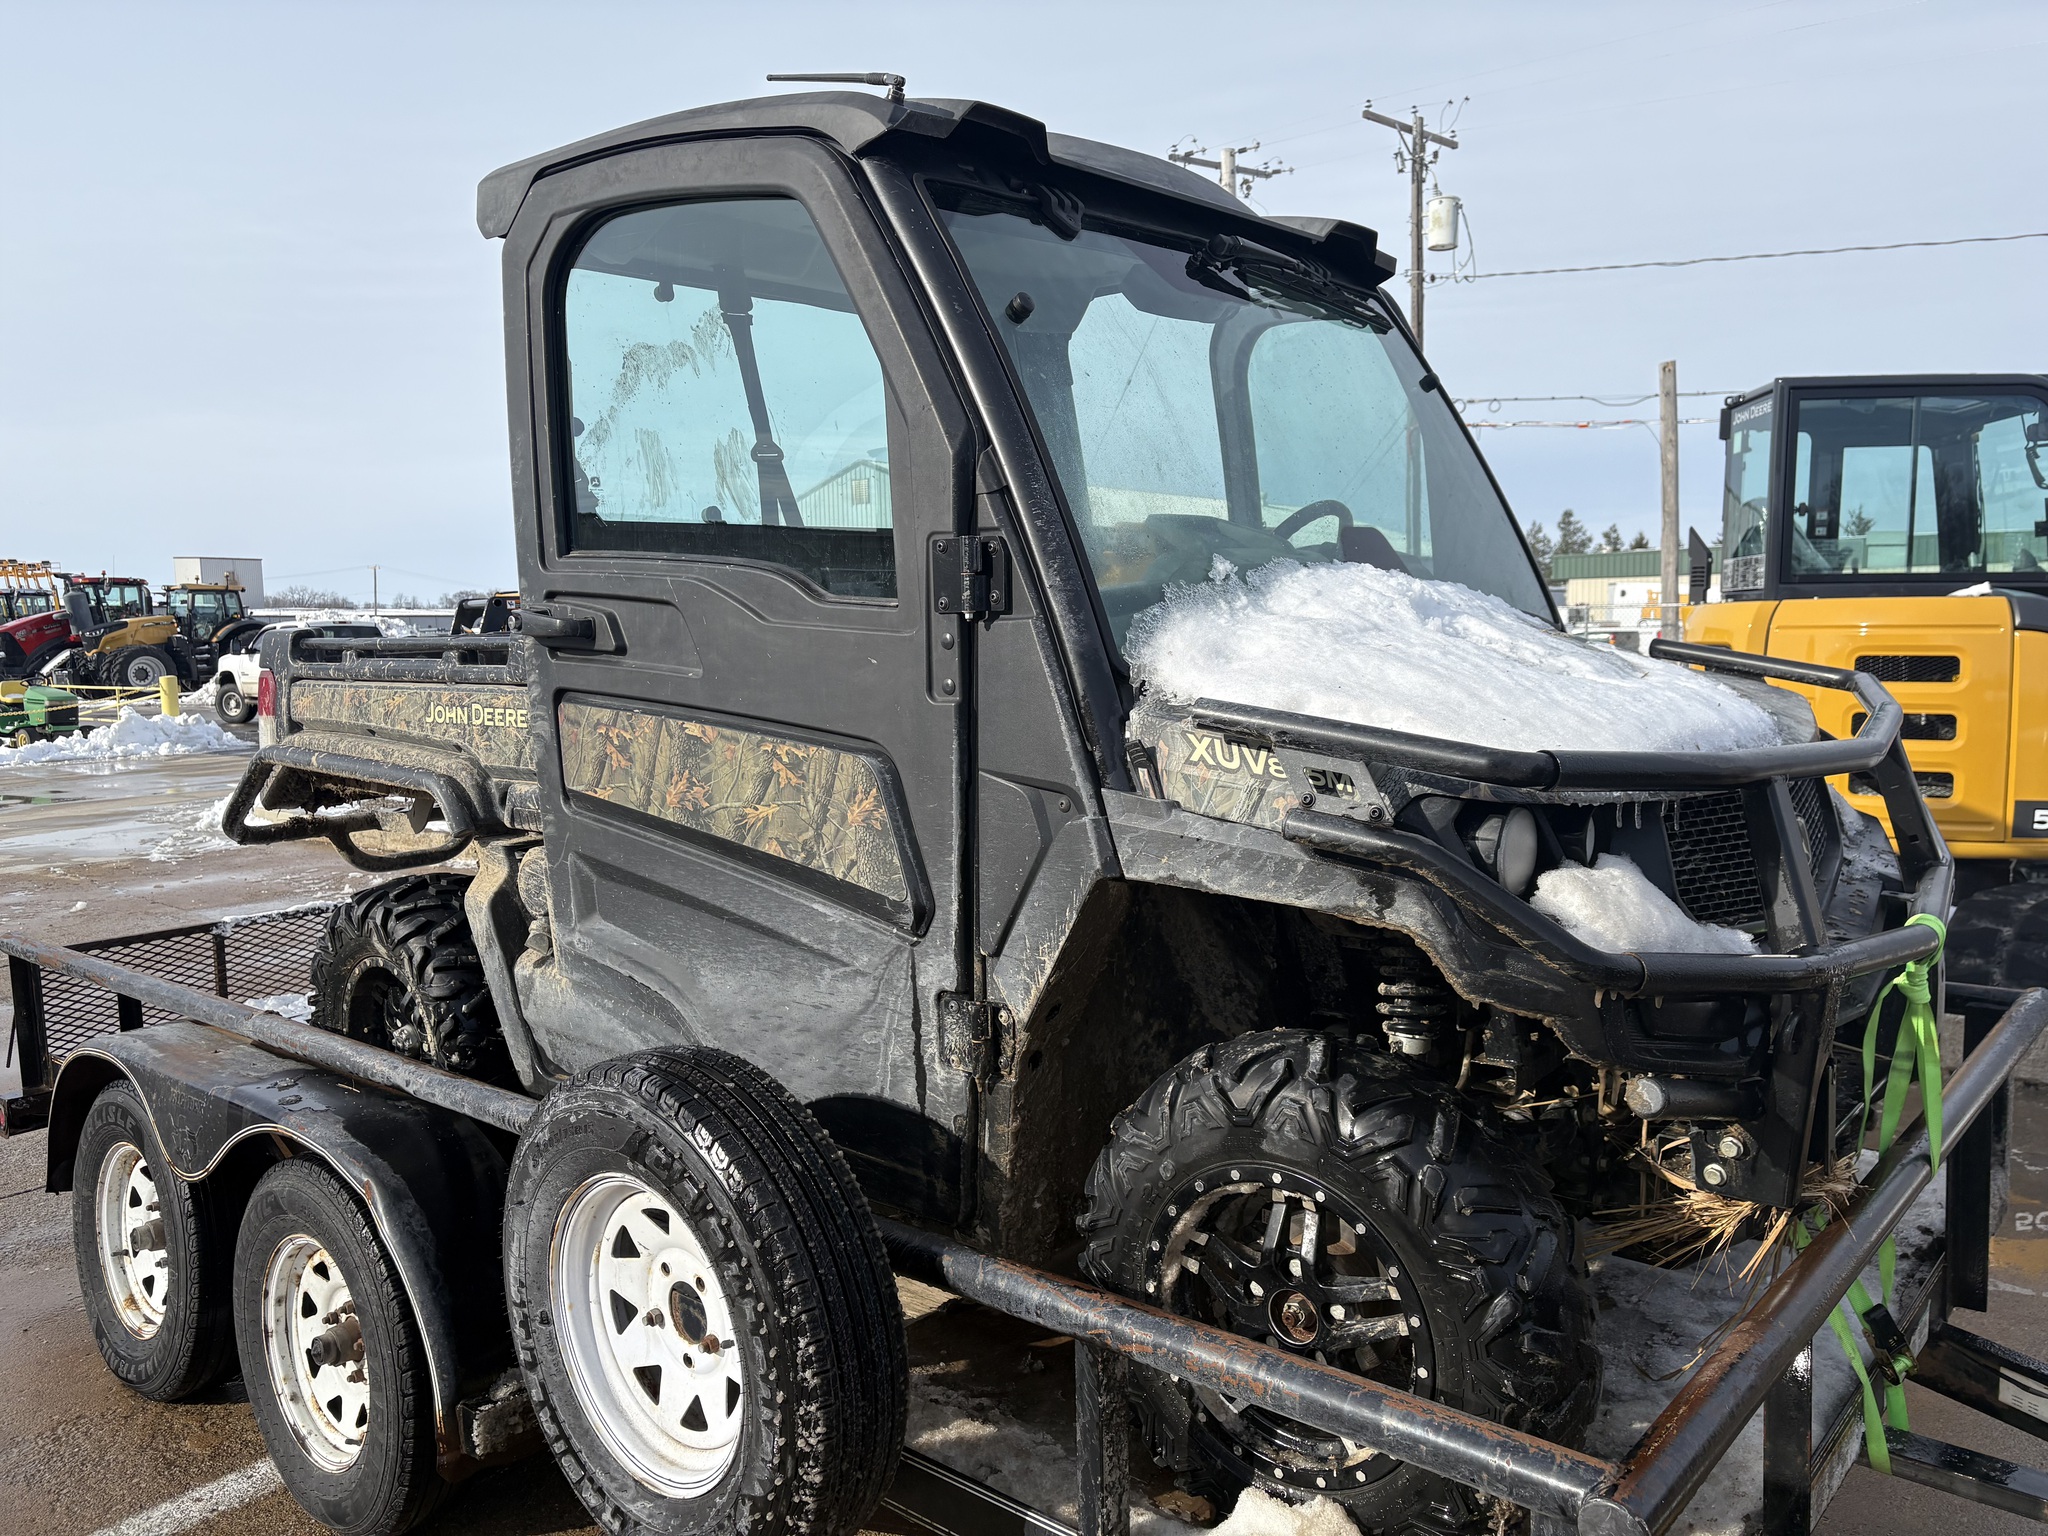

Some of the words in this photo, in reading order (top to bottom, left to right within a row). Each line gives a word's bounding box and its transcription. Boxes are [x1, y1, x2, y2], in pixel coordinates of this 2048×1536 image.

[1732, 410, 1750, 426] JOHN
[1750, 401, 1773, 419] DEERE
[425, 701, 468, 725] JOHN
[471, 703, 528, 728] DEERE
[1185, 732, 1354, 794] XUV85M
